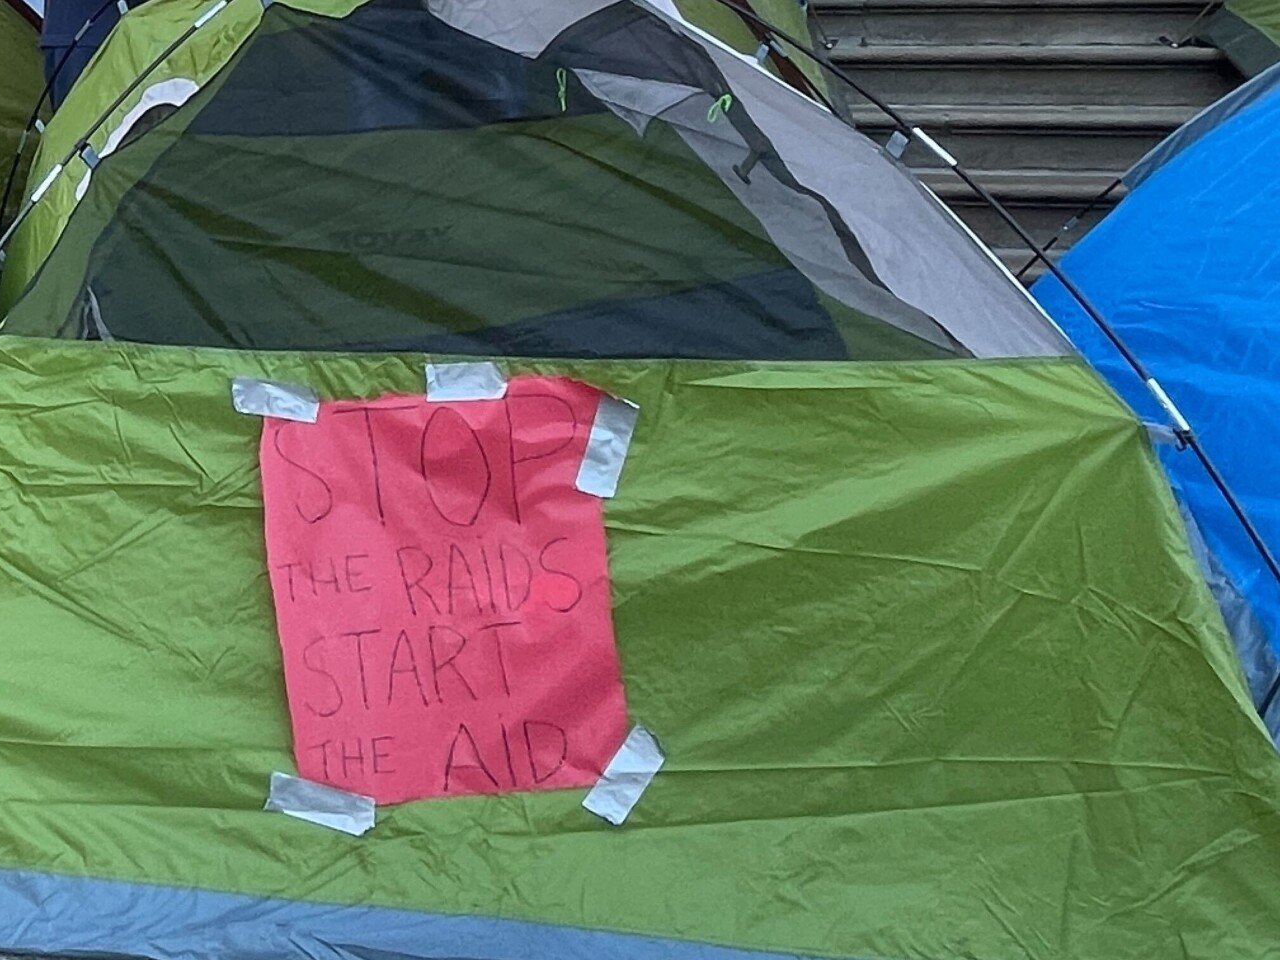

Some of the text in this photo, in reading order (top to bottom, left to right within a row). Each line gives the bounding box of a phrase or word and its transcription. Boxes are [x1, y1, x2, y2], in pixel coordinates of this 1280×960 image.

[274, 393, 578, 527] STOP
[277, 554, 373, 602] THE
[302, 620, 522, 718] START
[308, 736, 397, 779] THE
